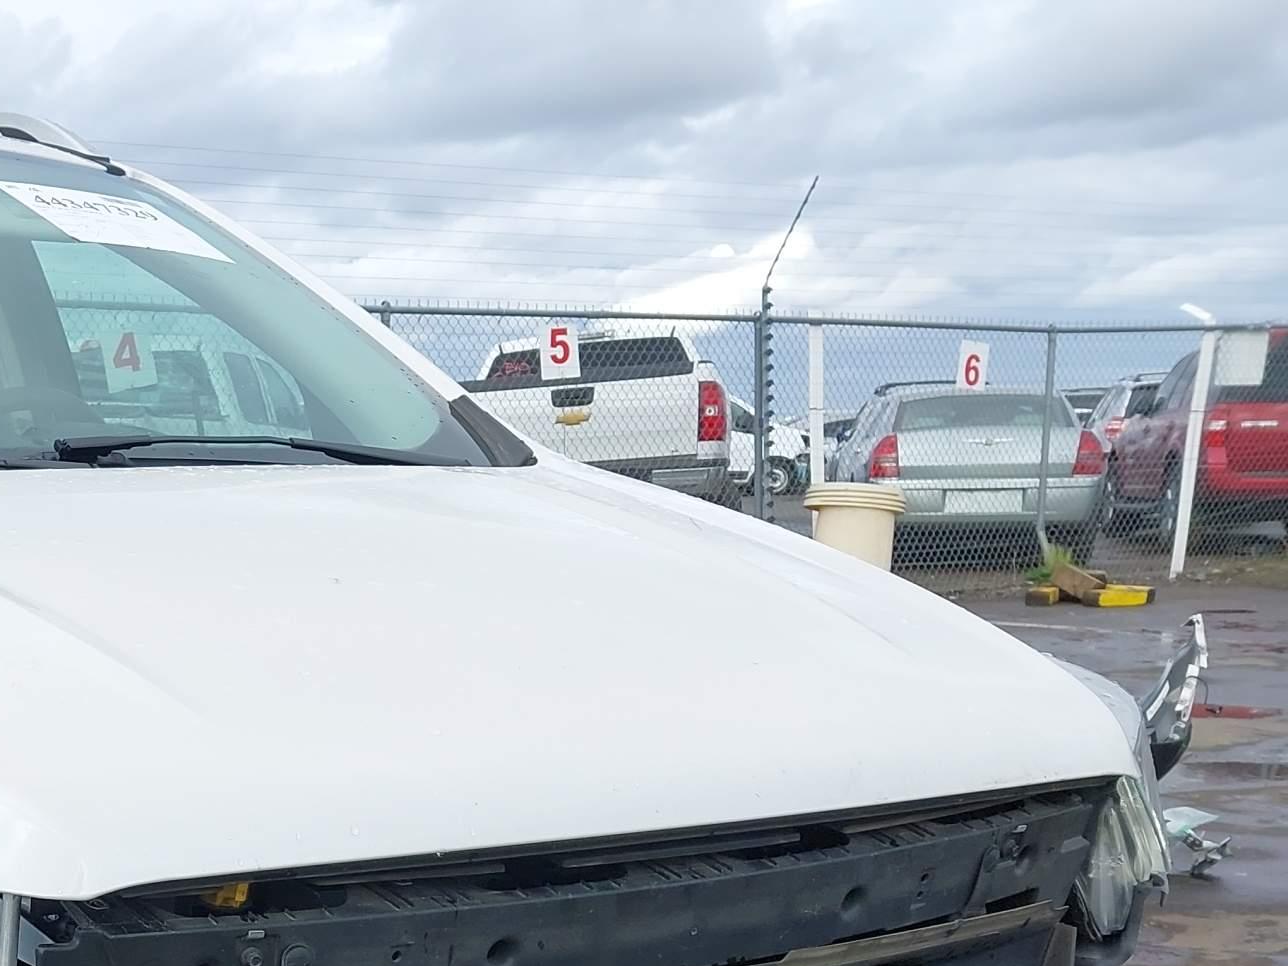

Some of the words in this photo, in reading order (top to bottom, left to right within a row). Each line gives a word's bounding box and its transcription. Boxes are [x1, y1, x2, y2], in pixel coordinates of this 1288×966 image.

[113, 331, 140, 372] 4
[550, 327, 570, 365] 5
[965, 353, 981, 386] 6
